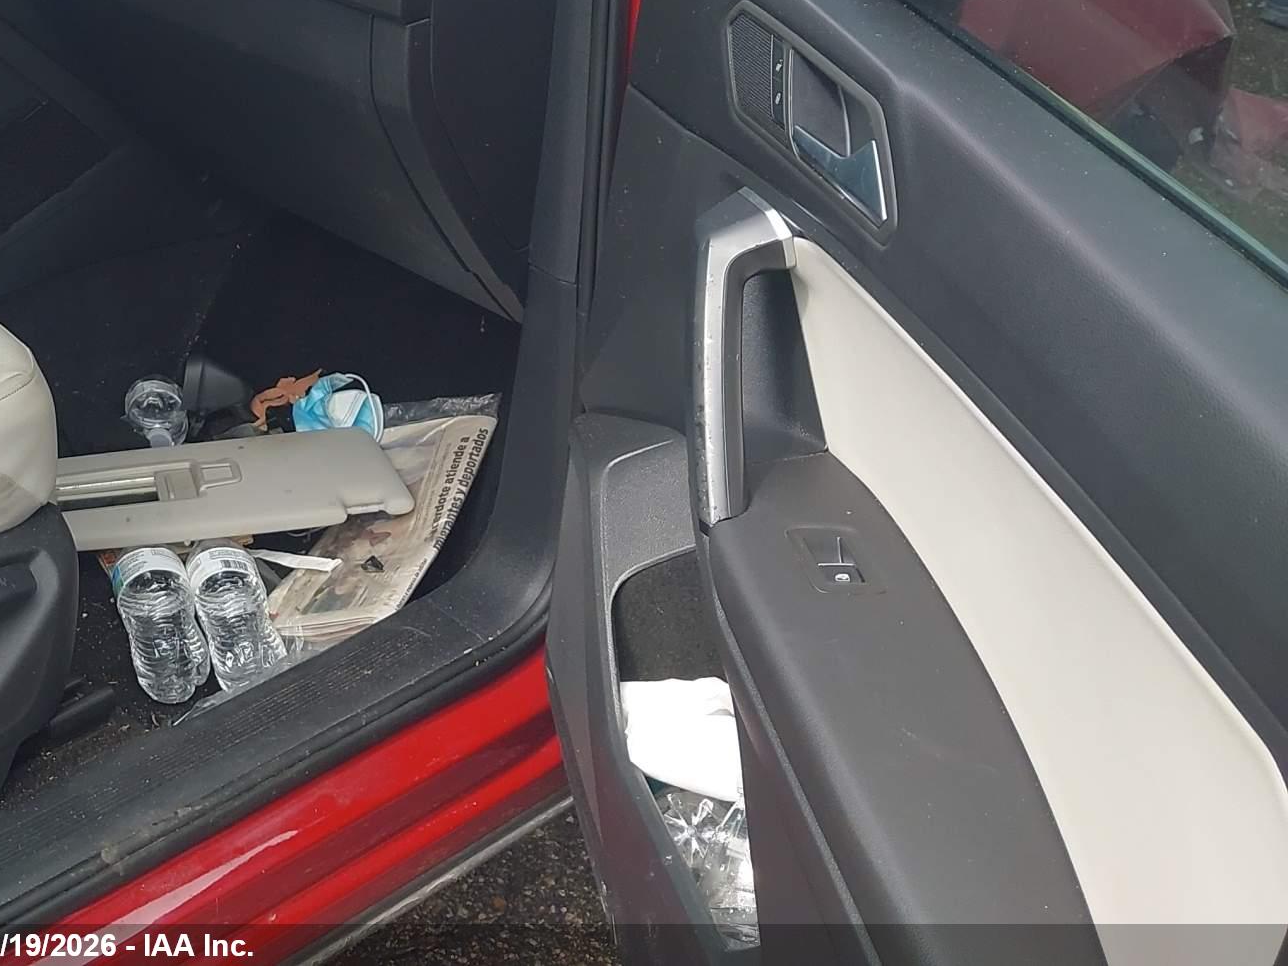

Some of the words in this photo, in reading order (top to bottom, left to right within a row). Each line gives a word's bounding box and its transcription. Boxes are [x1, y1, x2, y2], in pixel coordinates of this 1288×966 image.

[445, 444, 467, 485] atiende
[457, 427, 489, 489] deportados
[455, 487, 467, 498] y
[432, 497, 465, 552] migrantes
